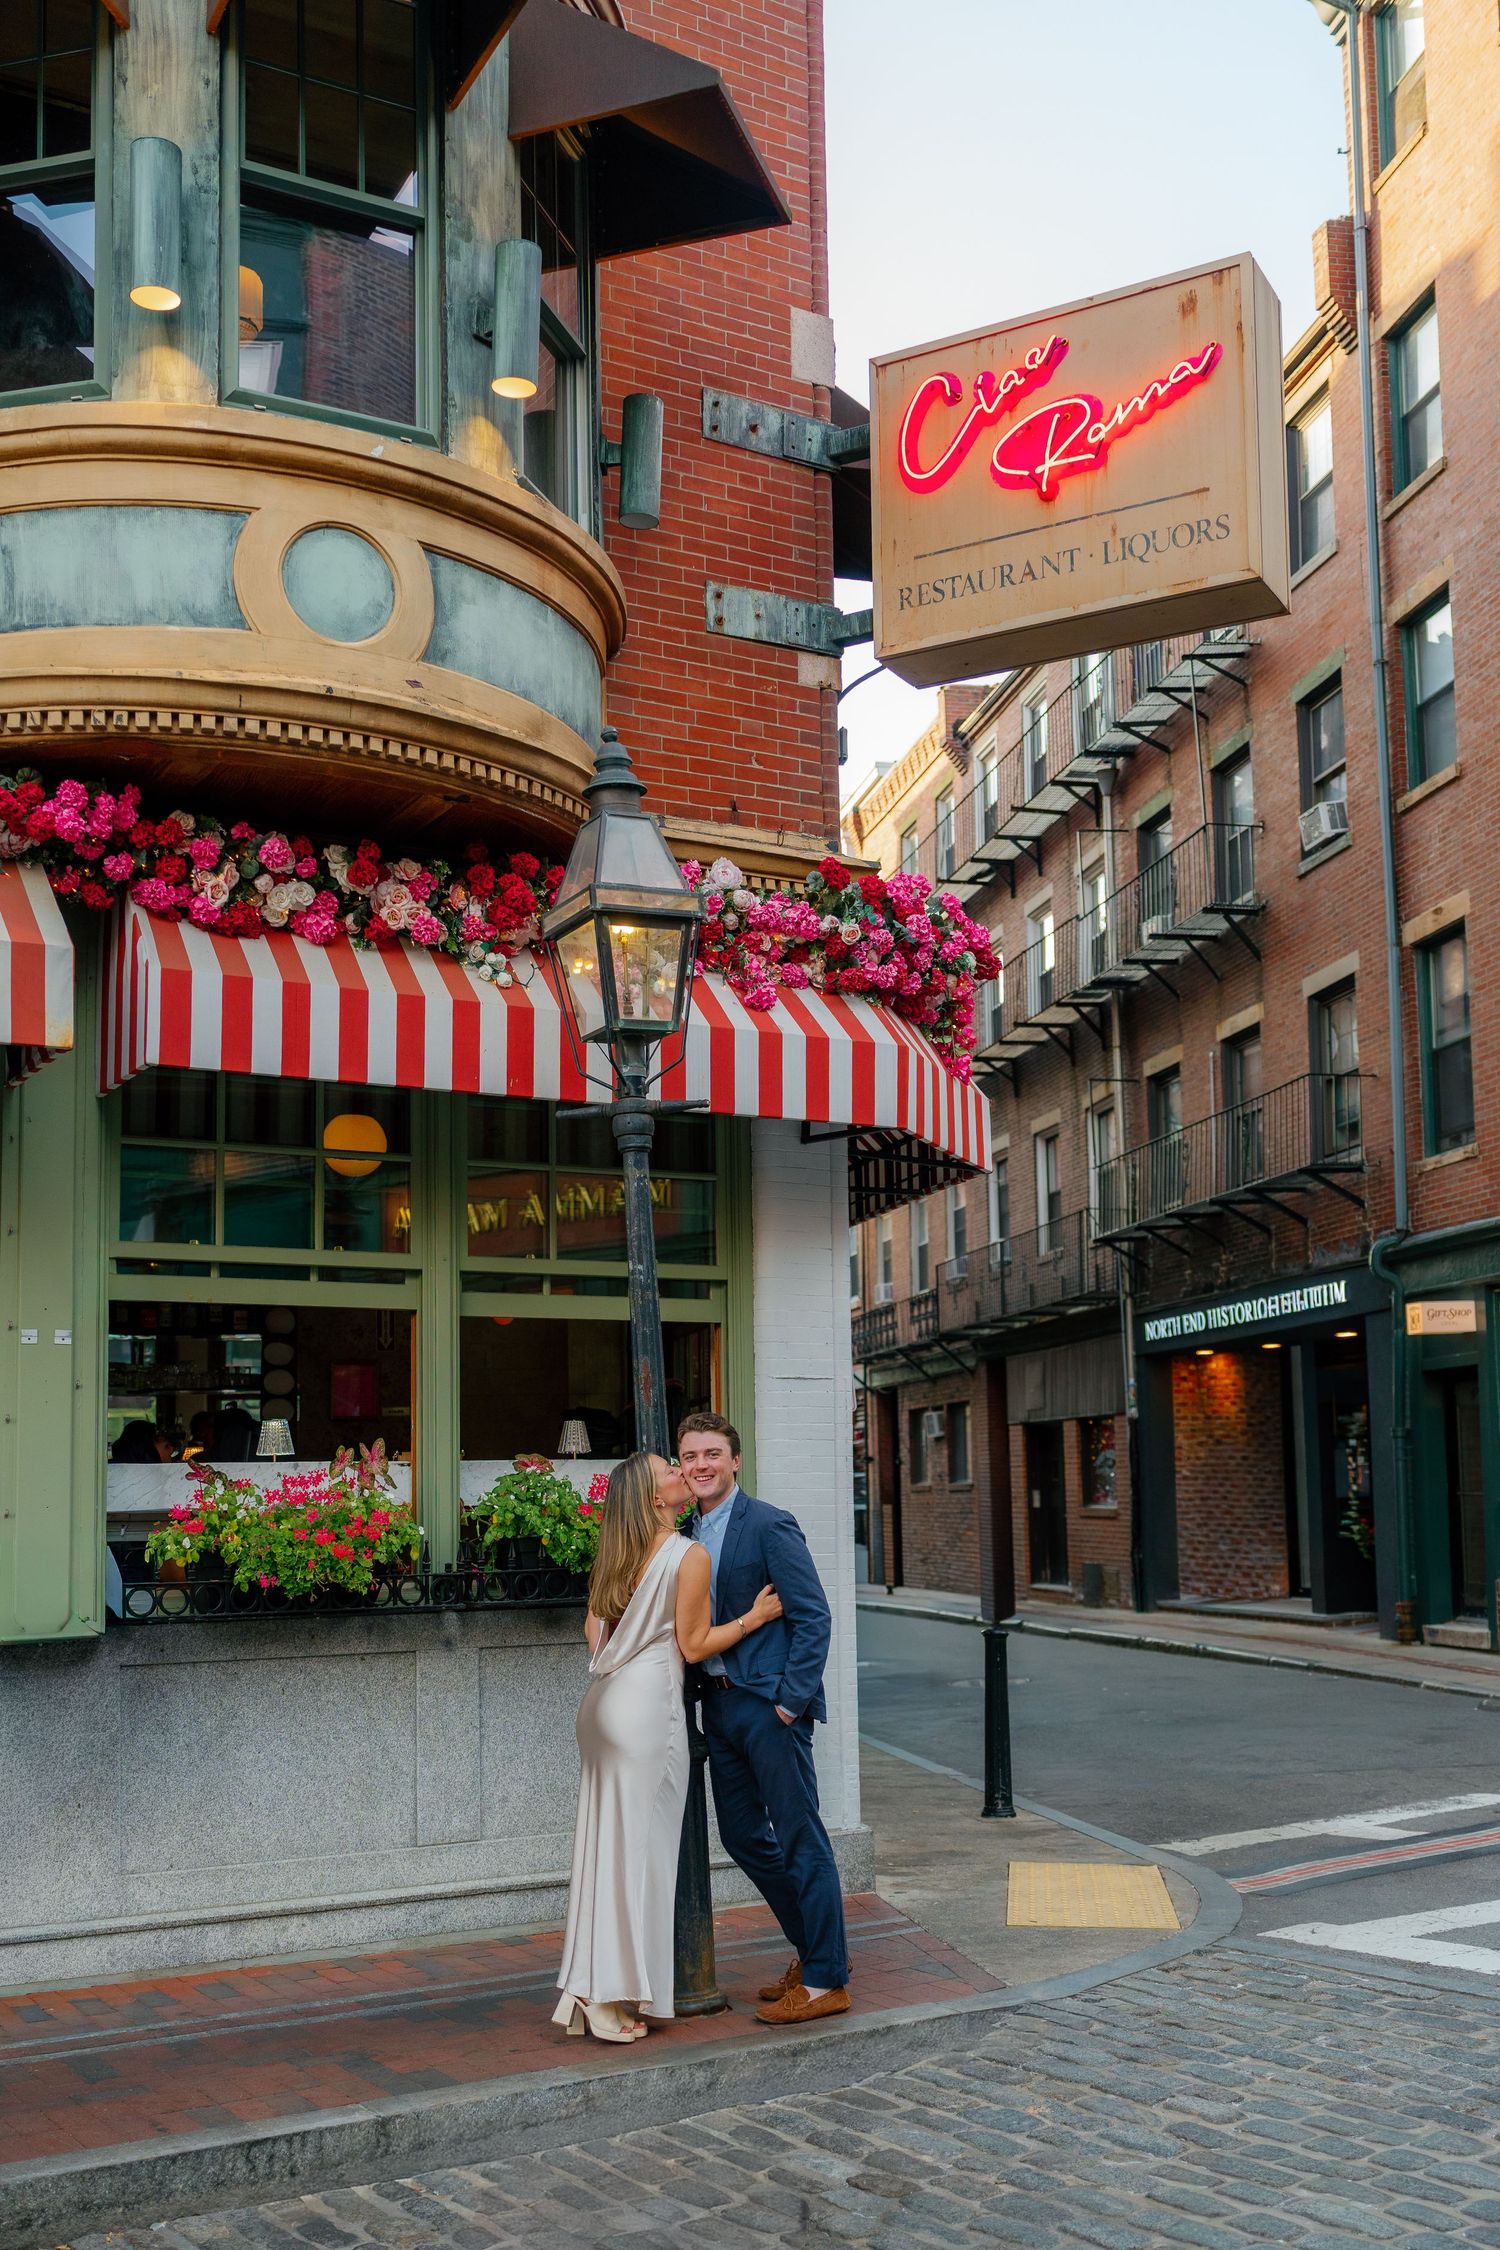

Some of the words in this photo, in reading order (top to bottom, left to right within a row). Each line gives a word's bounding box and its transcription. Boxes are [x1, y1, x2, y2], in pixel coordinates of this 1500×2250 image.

[991, 342, 1217, 493] Roma
[898, 548, 1081, 611] RESTAURANT
[1102, 513, 1231, 565] LIQUORS
[1144, 1315, 1182, 1341] NORTH
[1183, 1311, 1206, 1334] END
